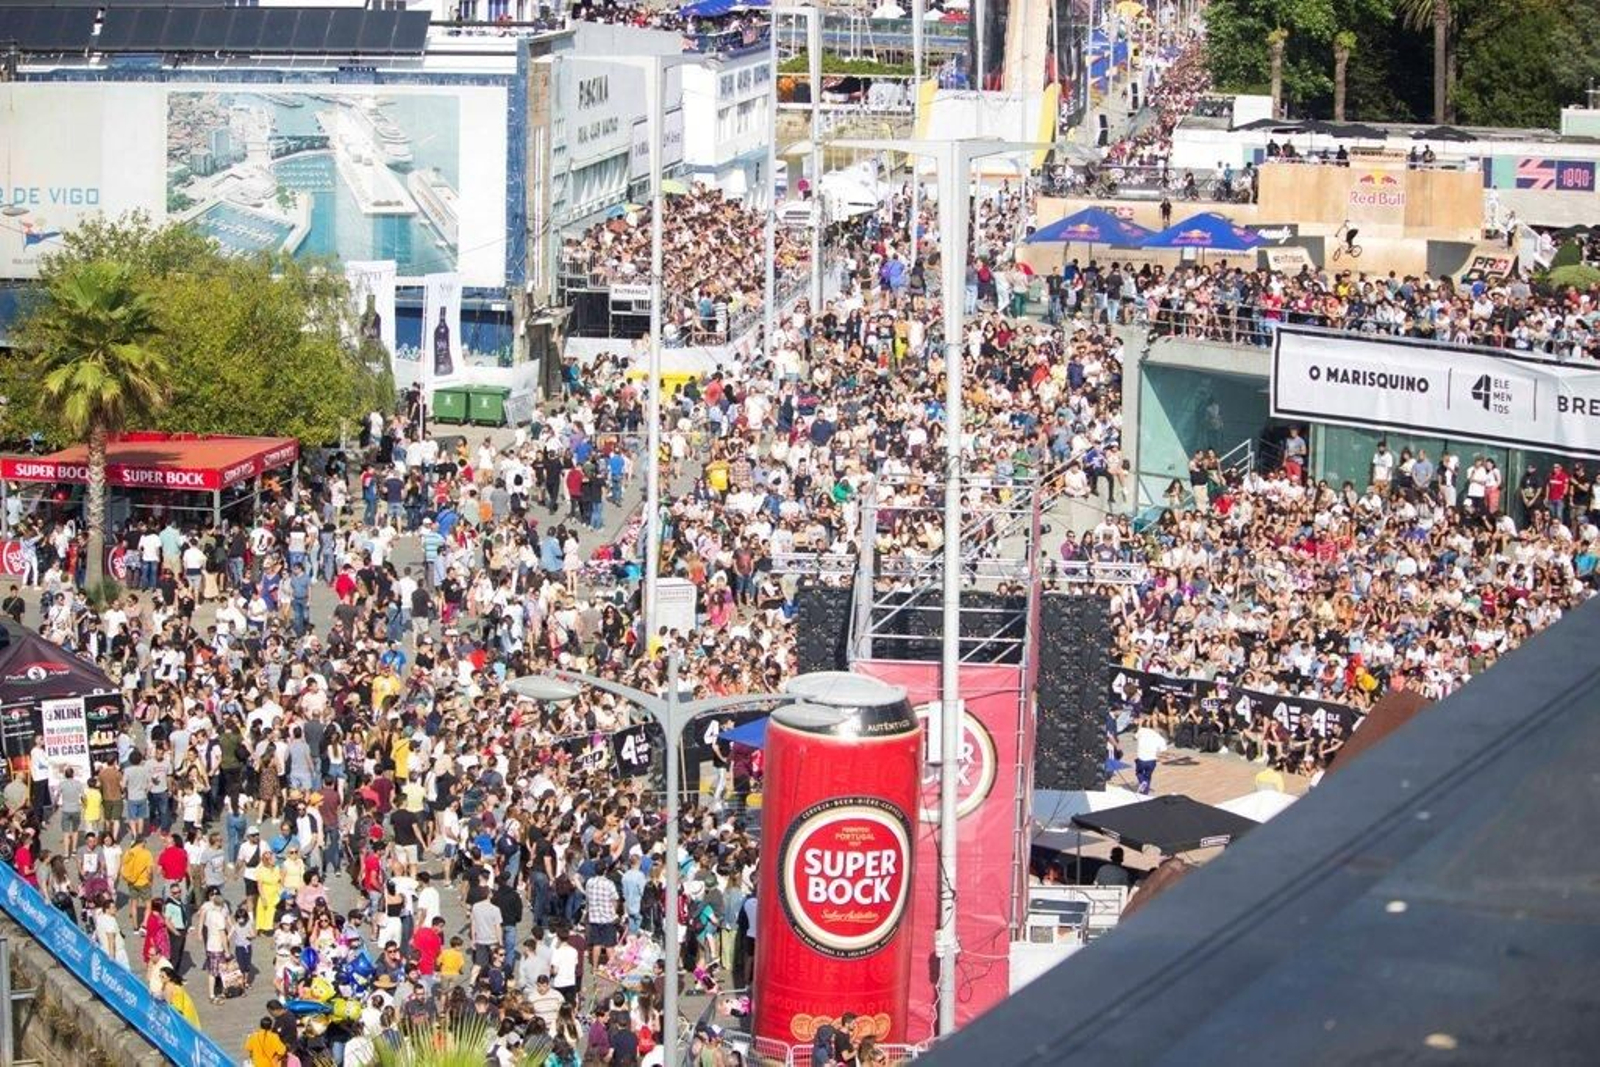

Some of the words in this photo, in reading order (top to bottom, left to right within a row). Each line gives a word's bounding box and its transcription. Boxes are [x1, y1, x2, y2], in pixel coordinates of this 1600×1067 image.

[14, 187, 40, 204] DE
[49, 187, 99, 205] VIGO
[1350, 191, 1376, 204] Red
[1379, 193, 1405, 205] Bull
[1308, 365, 1321, 381] O
[1326, 366, 1430, 393] MARISQUINO
[1494, 379, 1510, 389] ELE
[1471, 374, 1491, 412] 4
[1493, 391, 1513, 402] MEN
[1493, 403, 1510, 415] TOS
[1557, 394, 1600, 417] BRE
[15, 463, 55, 478] SUPER
[122, 469, 163, 484] SUPER
[166, 471, 205, 486] BOCK
[46, 734, 85, 746] DIRECTA
[48, 747, 59, 757] EN
[61, 745, 86, 756] CASA
[621, 735, 638, 765] 4
[804, 848, 896, 878] SUPER
[808, 876, 892, 905] BOCK
